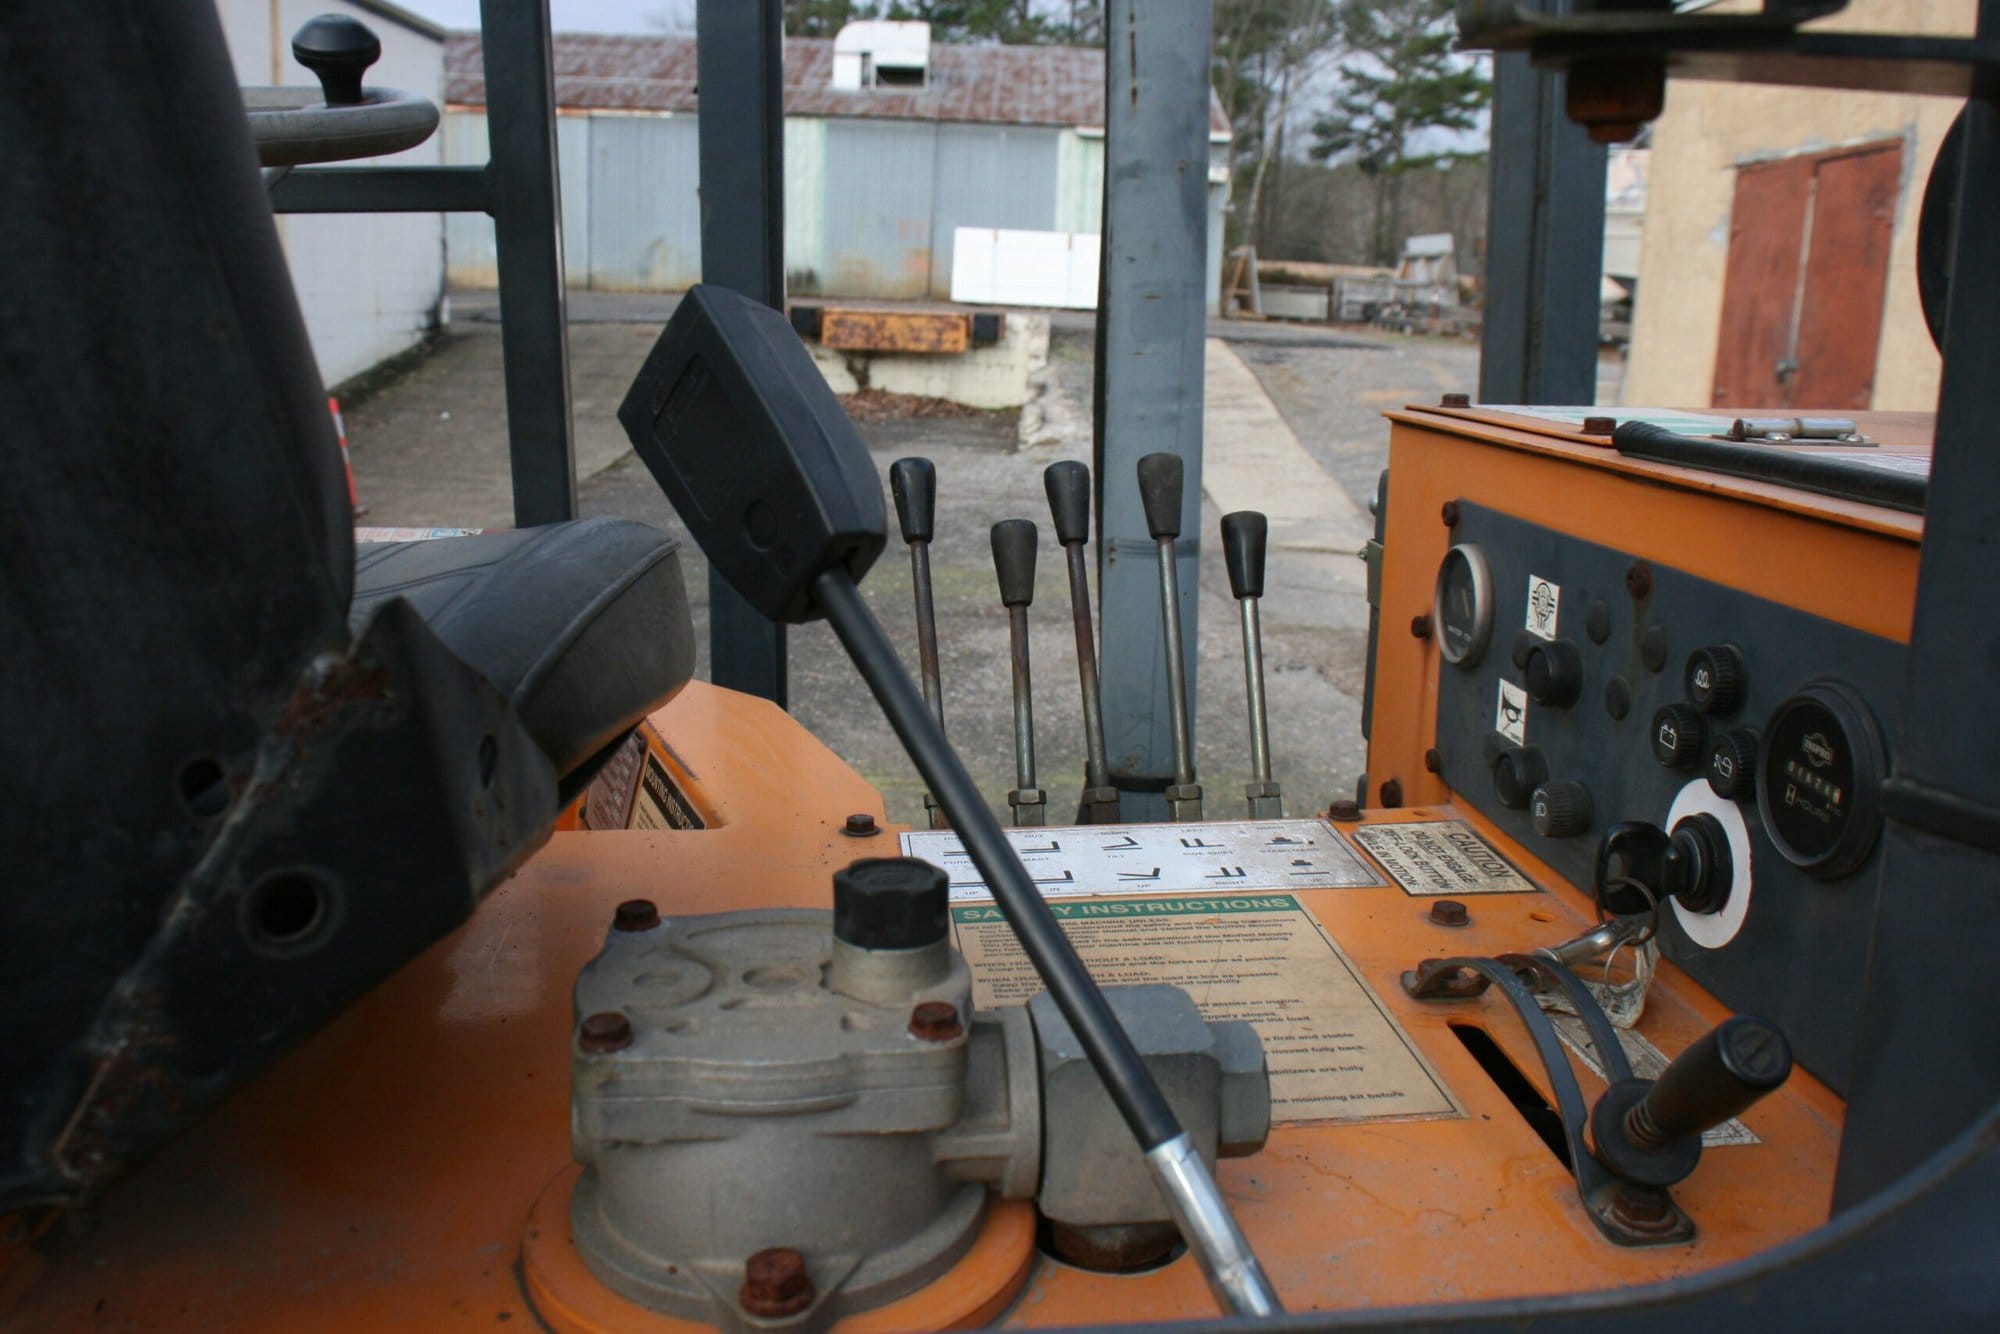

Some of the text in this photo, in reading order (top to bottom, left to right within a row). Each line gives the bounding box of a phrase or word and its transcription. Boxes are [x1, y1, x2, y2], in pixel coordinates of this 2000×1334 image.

[1448, 832, 1515, 878] CAUTION
[1414, 859, 1454, 889] BUTTON
[963, 898, 1290, 920] SAY INSTRUCTIONS
